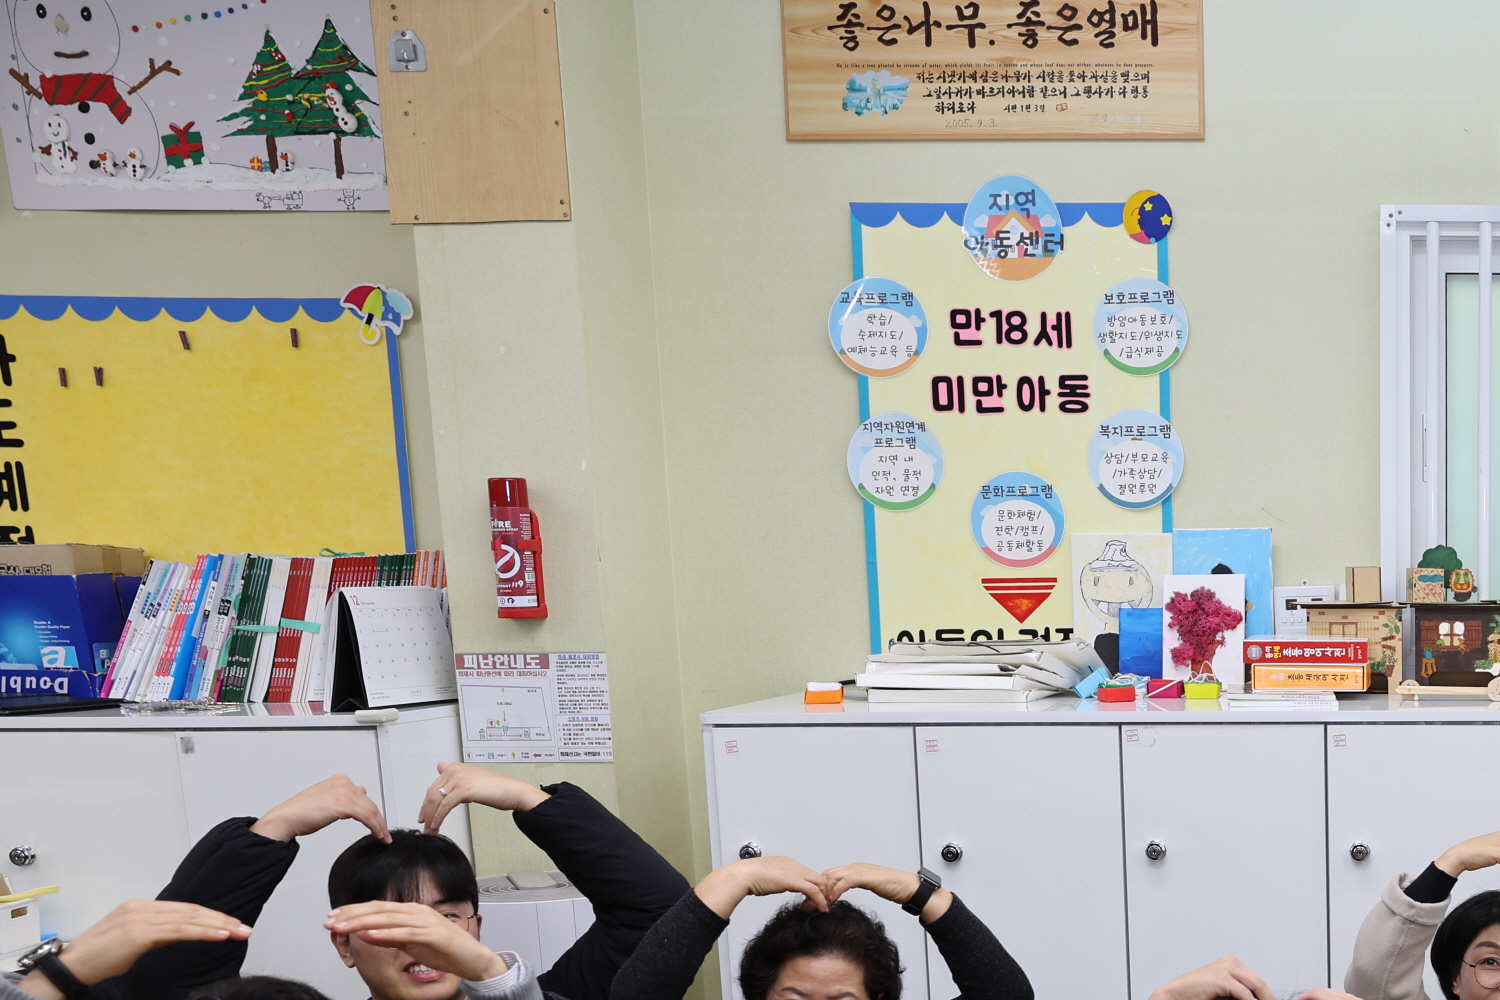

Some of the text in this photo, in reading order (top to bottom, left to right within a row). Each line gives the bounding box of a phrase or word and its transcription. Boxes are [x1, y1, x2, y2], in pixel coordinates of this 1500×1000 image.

[988, 188, 1037, 219] 지역
[963, 229, 1065, 260] 아동센터
[839, 290, 915, 308] 교육프로그램
[1104, 290, 1176, 306] 보호프로그램
[866, 312, 893, 326] 학습/
[1106, 313, 1174, 328] 방임아동보호/
[857, 329, 904, 342] 숙제지도/
[1098, 328, 1184, 343] 생활지도/위생지도
[1119, 344, 1165, 359] /급식제공
[862, 420, 927, 435] 지역자원연계
[1099, 424, 1173, 441] 복지프로그램
[873, 436, 918, 450] 프로그램
[878, 453, 914, 465] 지역 내
[1104, 451, 1171, 465] 상담/부모교육
[902, 469, 922, 482] 물적
[1112, 466, 1163, 480] /가족상담/
[874, 484, 920, 497] 자원 연결
[980, 484, 1054, 500] 문화프로그램
[997, 509, 1042, 522] 문화체험/
[994, 524, 1046, 537] 견학/캠프/
[996, 540, 1045, 553] 공동체활동
[512, 580, 524, 588] 119
[463, 654, 541, 670] 피난안내도
